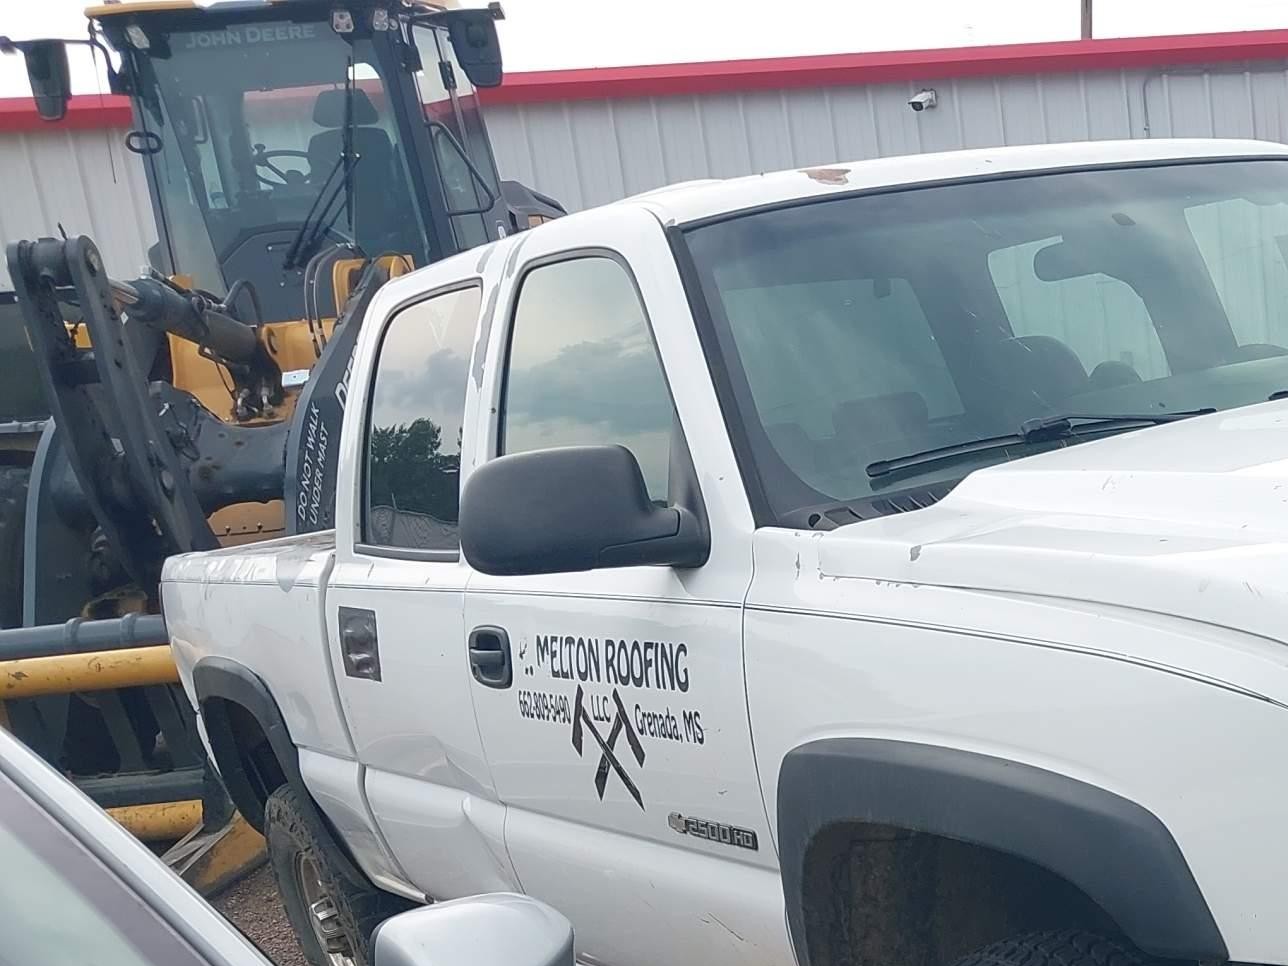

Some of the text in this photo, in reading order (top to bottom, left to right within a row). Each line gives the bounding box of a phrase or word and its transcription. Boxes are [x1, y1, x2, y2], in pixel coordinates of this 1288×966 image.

[185, 24, 316, 49] JOHN DEERE
[297, 401, 320, 521] DO NOT WALK
[309, 421, 329, 525] UNDER MAST
[536, 634, 601, 683] MELTON
[604, 639, 689, 693] ROOFING
[518, 689, 572, 725] 662-809-5490
[591, 694, 611, 723] LLC
[634, 703, 704, 745] Grenada, MS
[687, 817, 759, 850] 2500HD
